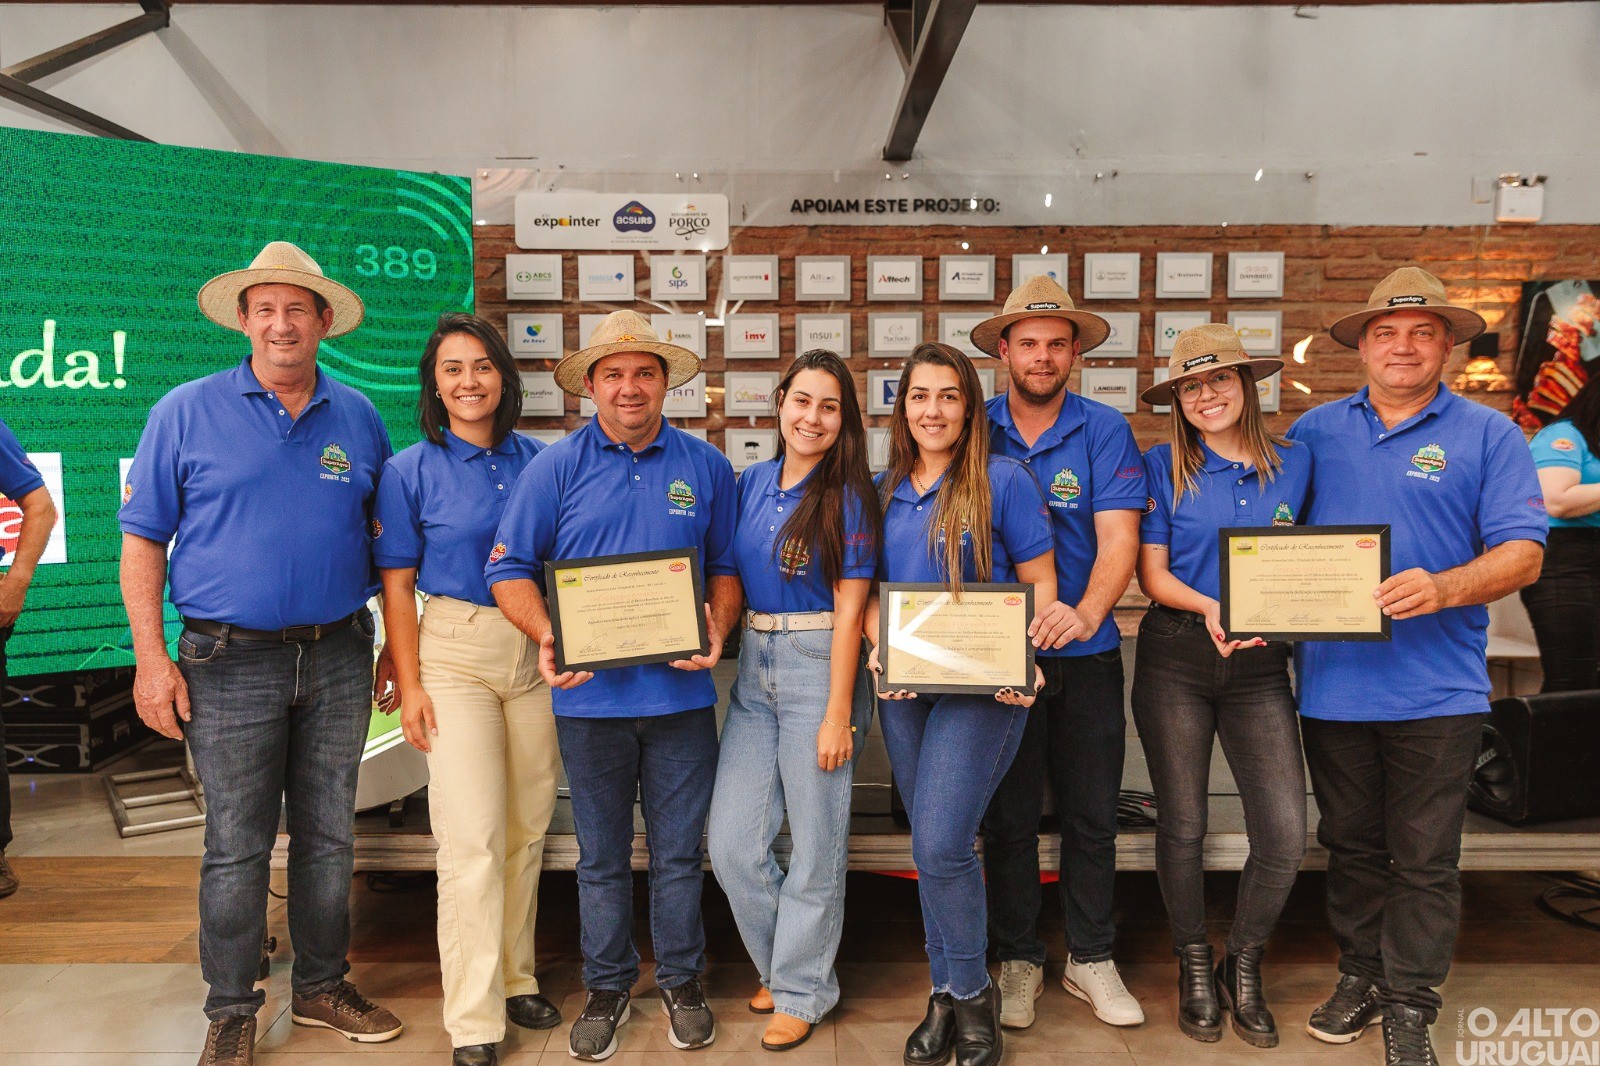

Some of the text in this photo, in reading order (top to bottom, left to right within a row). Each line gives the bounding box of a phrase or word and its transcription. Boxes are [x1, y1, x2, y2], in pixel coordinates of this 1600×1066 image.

[790, 199, 859, 213] APOIAM
[864, 199, 908, 213] ESTE
[669, 218, 710, 230] PORCO
[355, 244, 437, 280] 389
[668, 279, 688, 289] sips
[745, 331, 766, 340] imv
[0, 319, 127, 390] da!
[1186, 355, 1213, 366] SuperAgro
